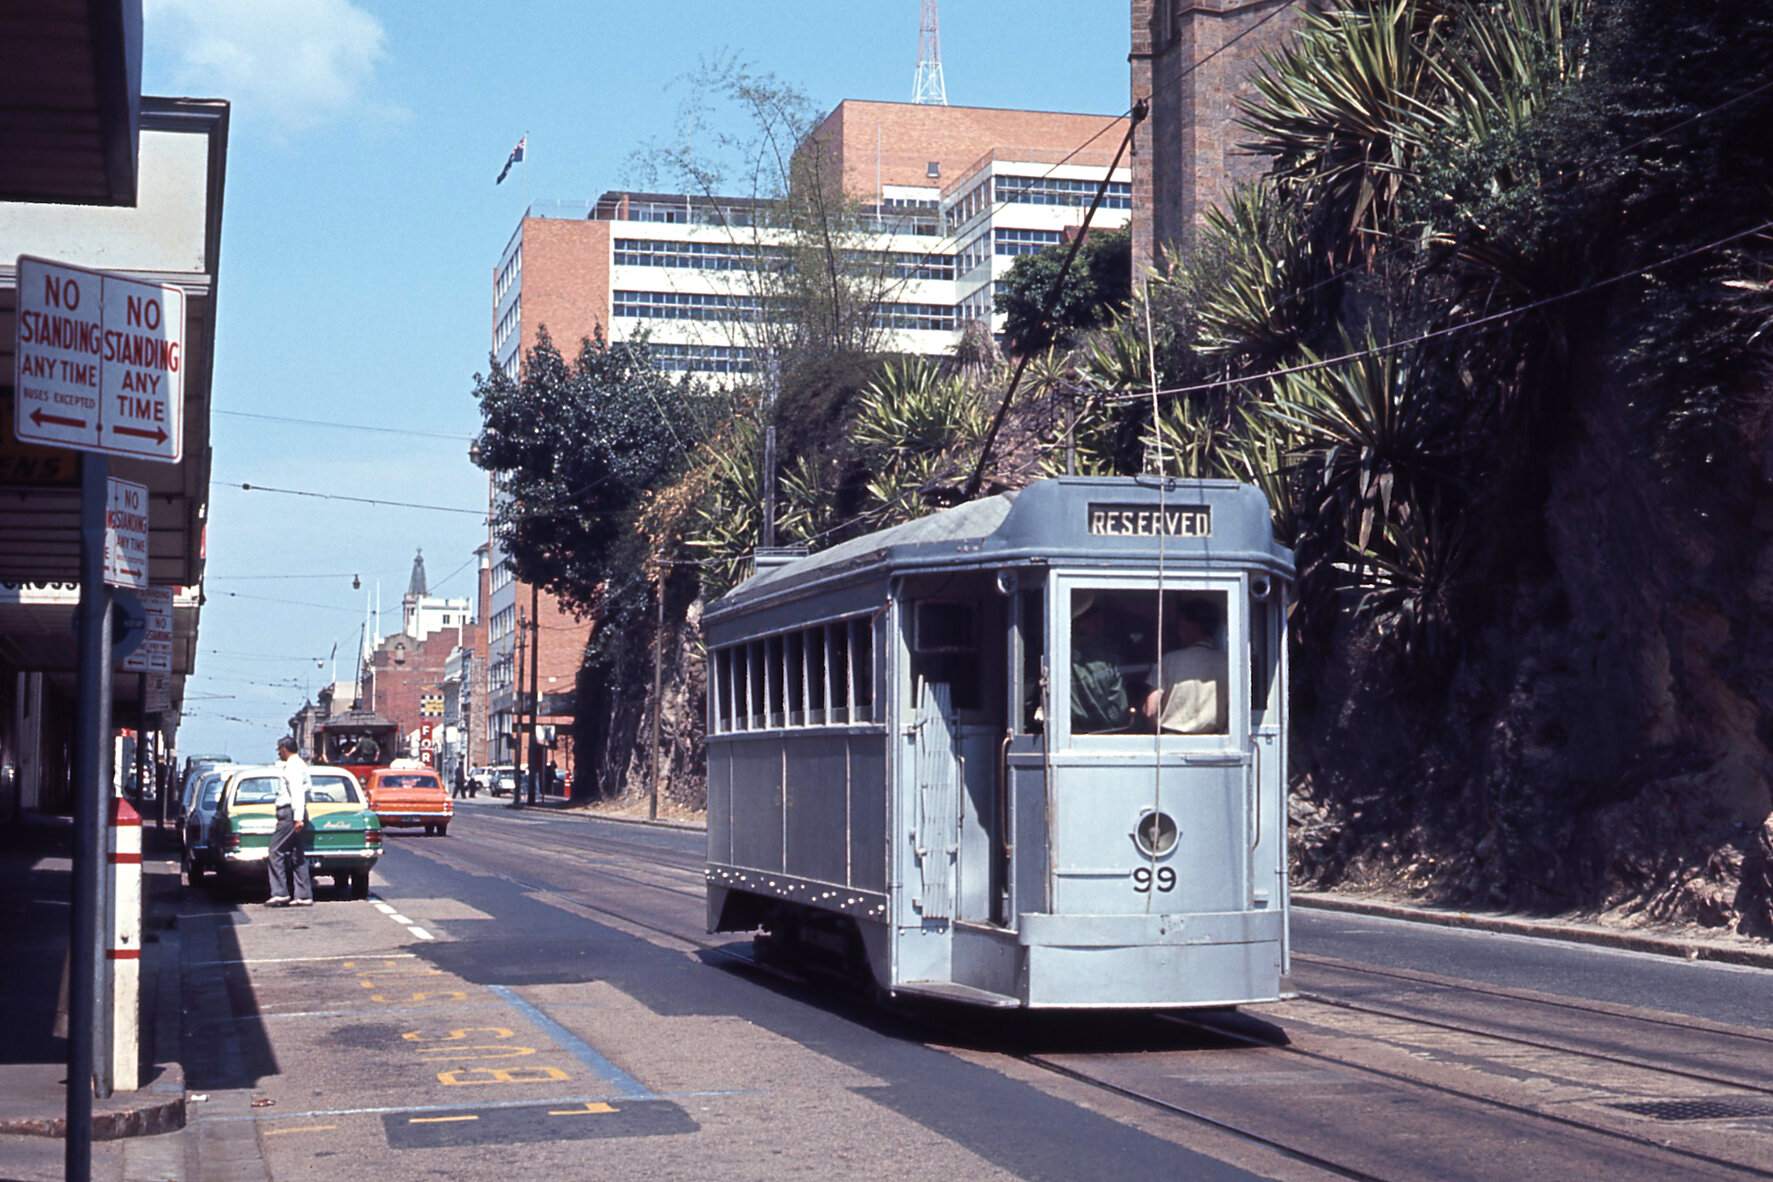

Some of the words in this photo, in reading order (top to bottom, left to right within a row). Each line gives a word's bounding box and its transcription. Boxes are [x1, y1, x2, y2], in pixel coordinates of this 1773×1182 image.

[45, 274, 80, 311] NO
[127, 295, 161, 331] NO
[21, 310, 100, 355] STANDING
[104, 330, 179, 373] STANDING
[22, 354, 57, 382] ANY
[61, 360, 97, 387] TIME
[122, 370, 161, 395] ANY
[23, 387, 49, 402] BUSES
[54, 392, 96, 409] EXCEPTED
[116, 394, 165, 422] TIME
[125, 489, 139, 510] NO
[1092, 511, 1208, 536] RESERVED
[1133, 866, 1177, 893] 99
[402, 1027, 571, 1086] BUS
